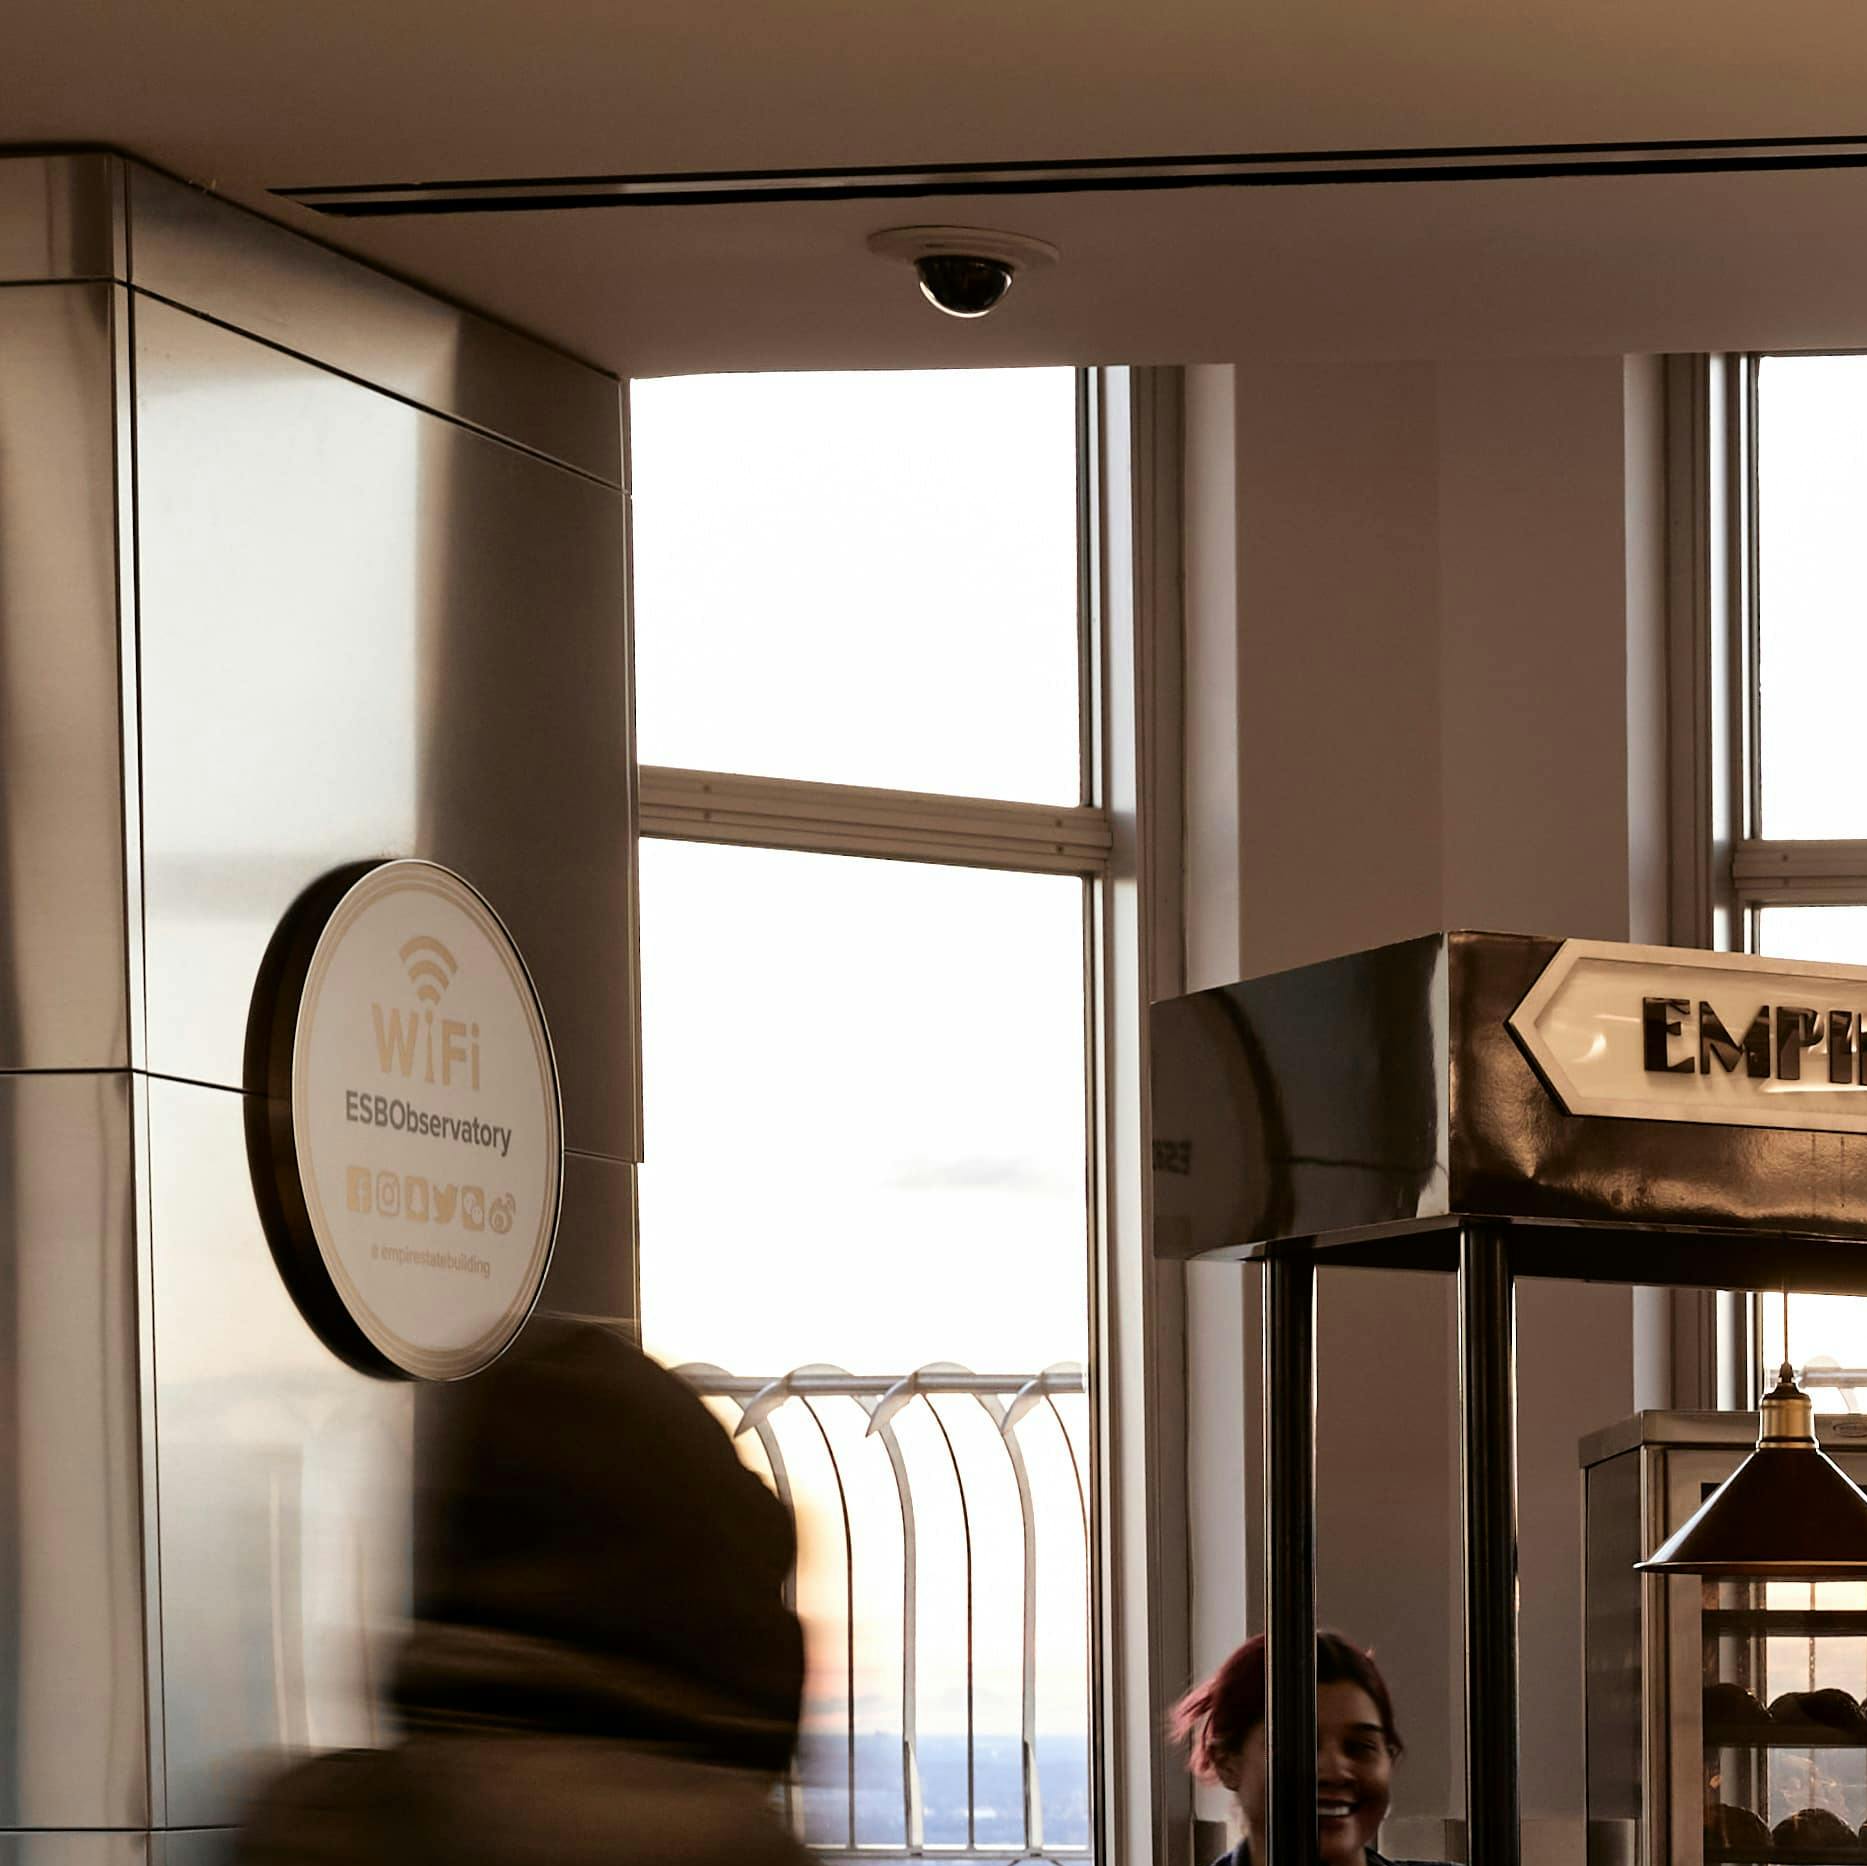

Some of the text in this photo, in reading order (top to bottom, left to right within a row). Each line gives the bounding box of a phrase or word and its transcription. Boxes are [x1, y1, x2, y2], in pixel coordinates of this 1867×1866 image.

[371, 1001, 480, 1091] WiFi
[345, 1089, 512, 1157] ESBObservatory
[381, 1245, 490, 1279] empirestatebuilding
